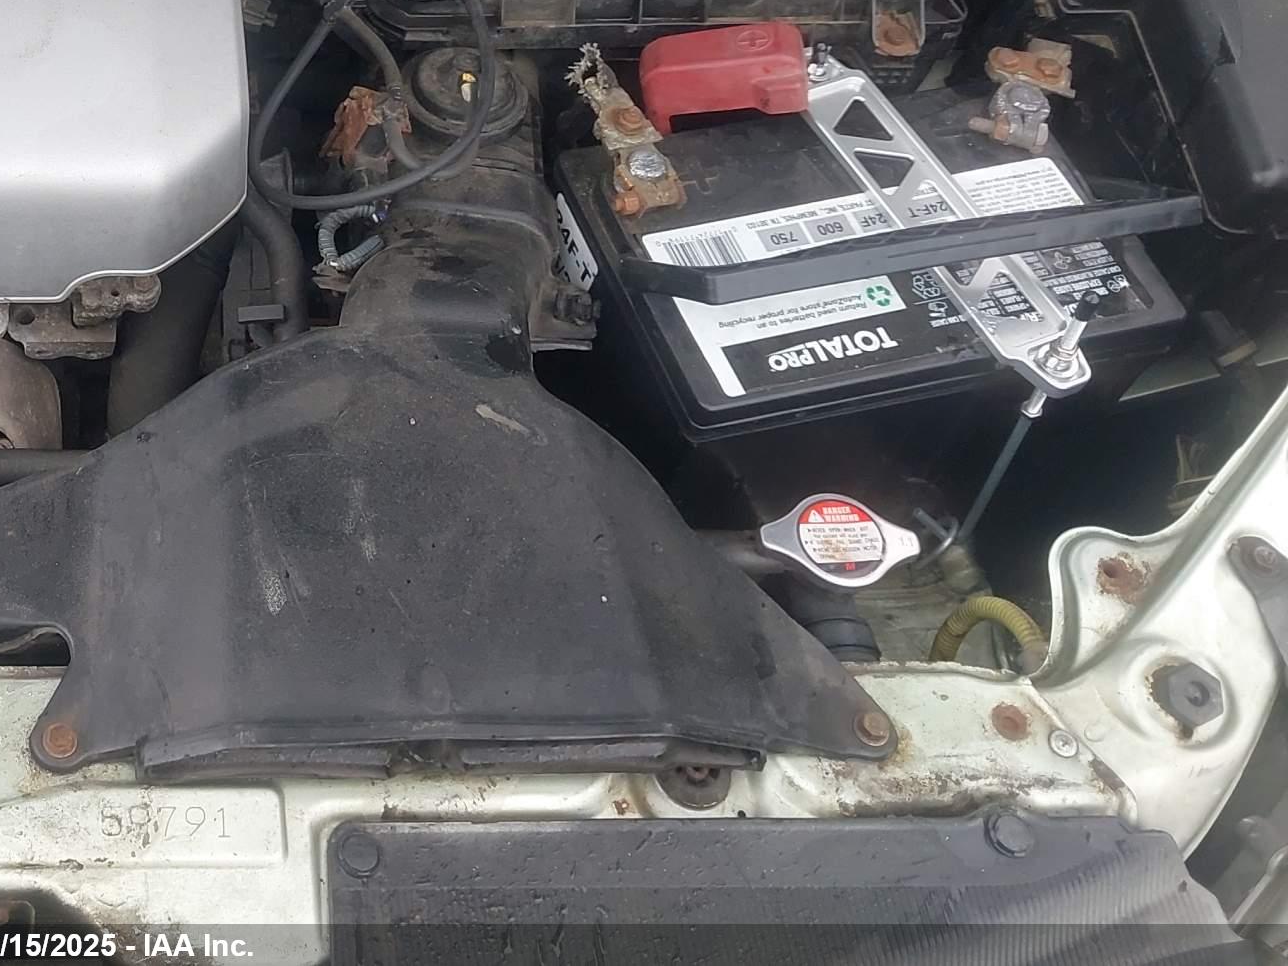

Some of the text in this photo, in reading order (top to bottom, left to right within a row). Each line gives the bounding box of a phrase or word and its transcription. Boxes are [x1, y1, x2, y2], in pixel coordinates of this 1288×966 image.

[908, 201, 948, 218] 24F-T
[861, 213, 888, 228] 24F
[817, 221, 844, 236] 600
[770, 231, 798, 246] 750
[767, 327, 899, 372] TOTALPRO
